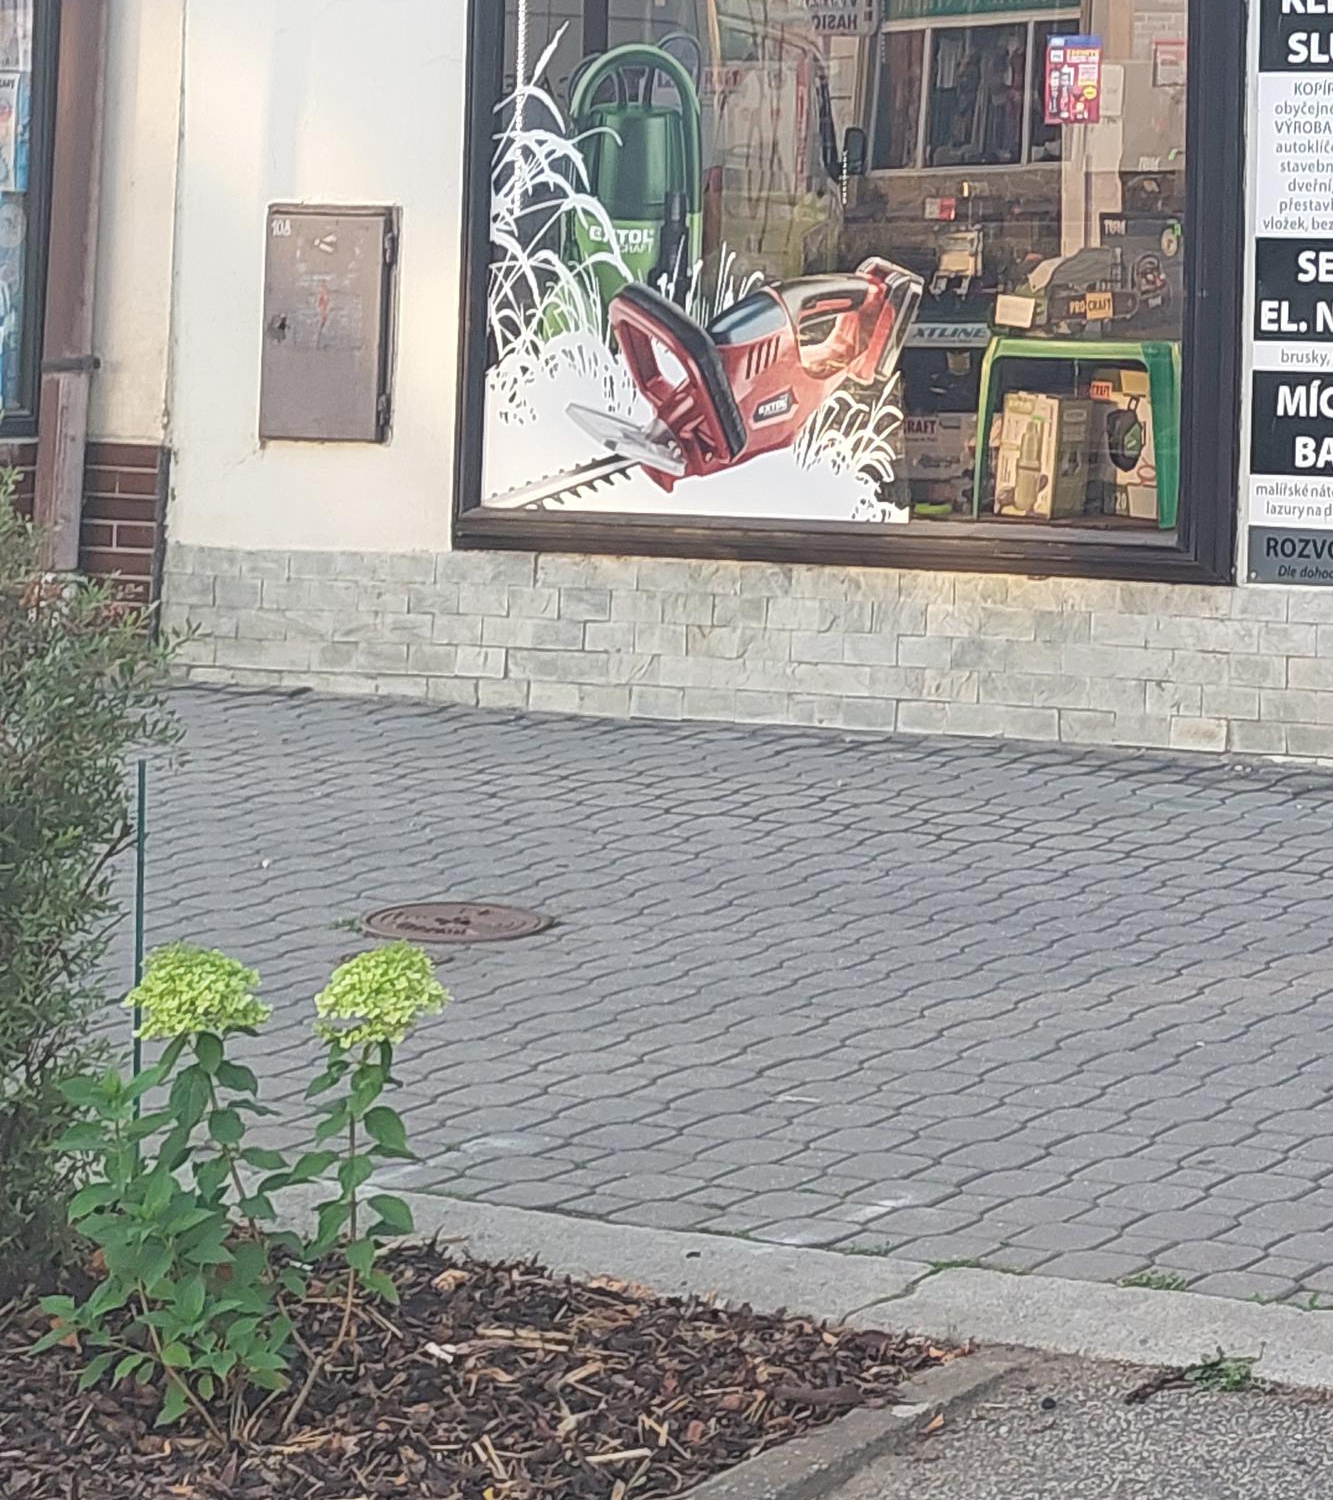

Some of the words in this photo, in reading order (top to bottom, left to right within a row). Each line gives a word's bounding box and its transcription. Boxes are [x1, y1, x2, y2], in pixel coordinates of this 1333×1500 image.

[1275, 118, 1331, 134] VÝROBA
[1263, 216, 1308, 232] vložek,
[1260, 300, 1308, 333] EL.
[1281, 349, 1330, 366] brusky,
[1256, 483, 1308, 497] malířské
[1266, 502, 1304, 519] lazury
[1307, 506, 1321, 516] na
[1279, 565, 1297, 577] Dle
